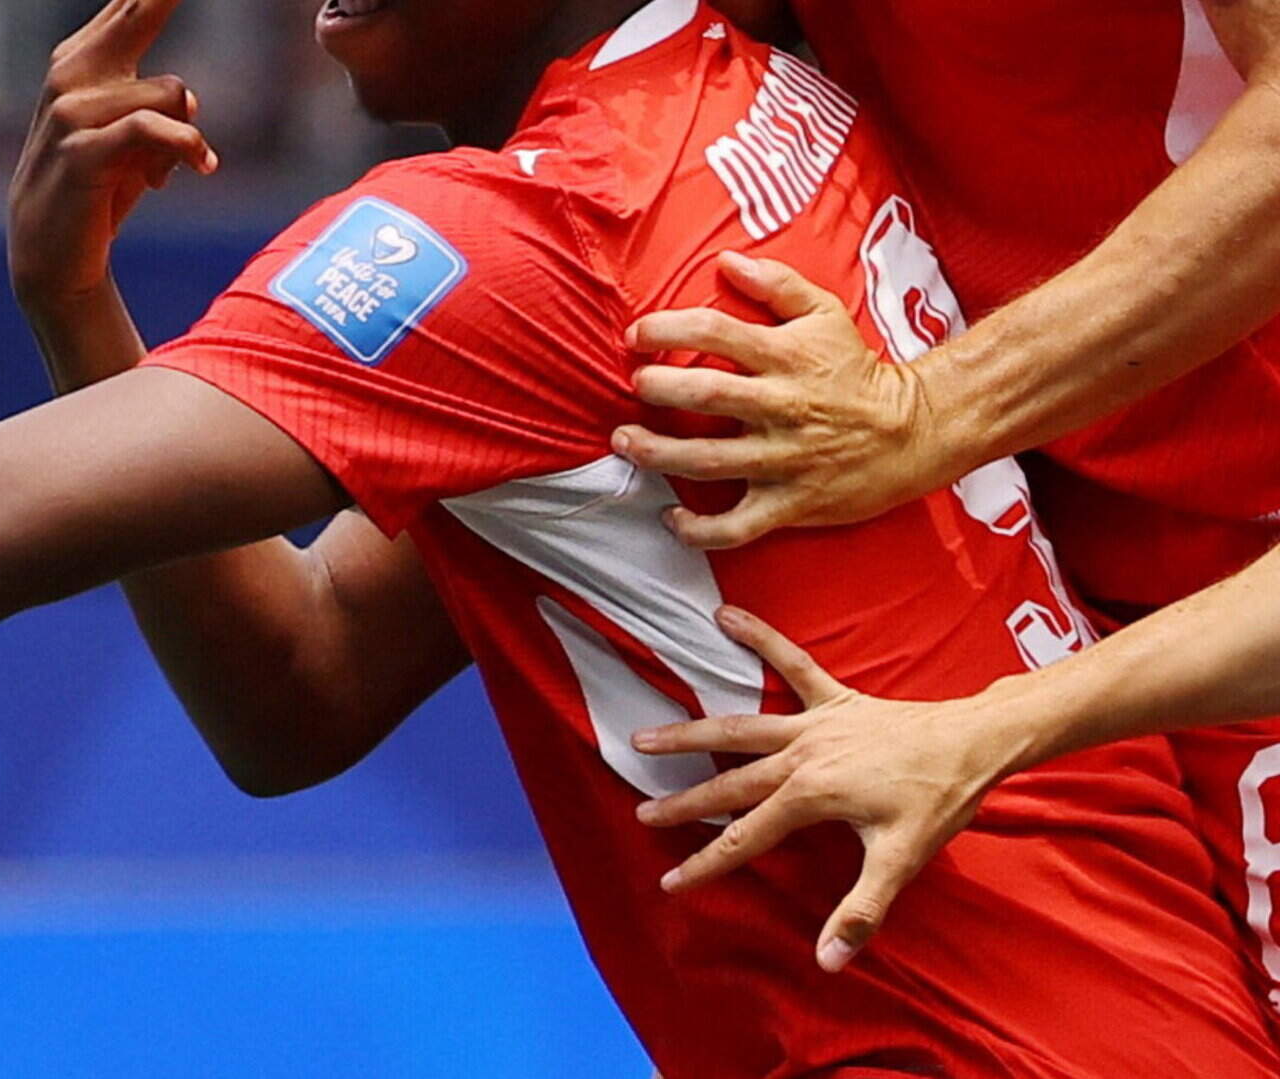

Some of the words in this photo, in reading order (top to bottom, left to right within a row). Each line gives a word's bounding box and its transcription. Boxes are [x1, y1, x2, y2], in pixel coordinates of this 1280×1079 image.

[704, 45, 860, 241] MANZAM
[314, 294, 347, 327] FIFA
[315, 266, 381, 323] PEACE
